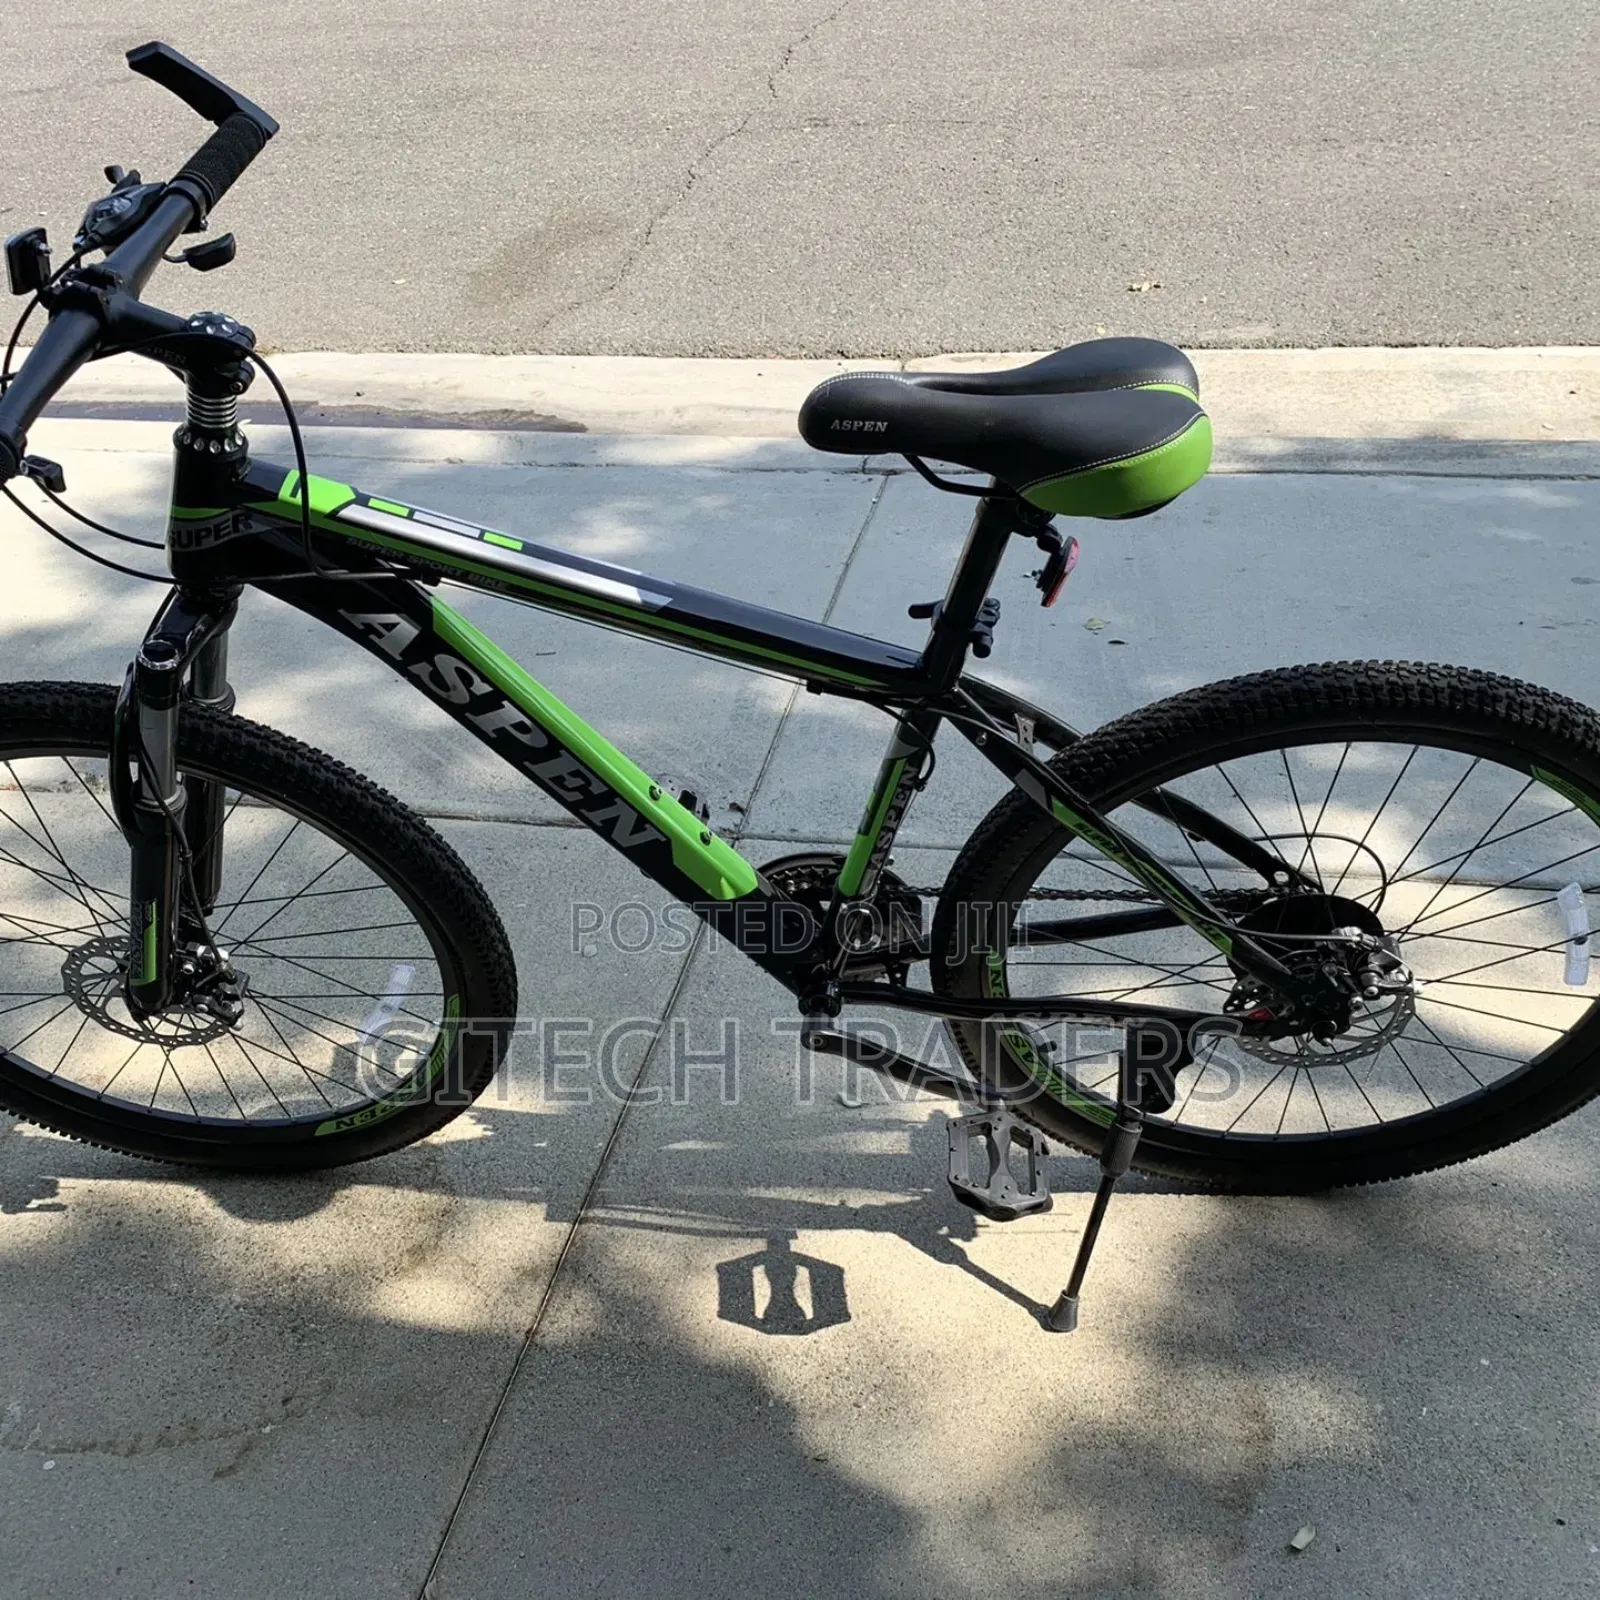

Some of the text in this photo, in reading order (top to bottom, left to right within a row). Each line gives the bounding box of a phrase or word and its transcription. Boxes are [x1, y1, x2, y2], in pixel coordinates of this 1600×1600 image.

[830, 418, 889, 433] ASPEN
[468, 572, 509, 592] BIKE
[338, 607, 667, 850] ASPEN
[869, 763, 920, 871] ASPEN
